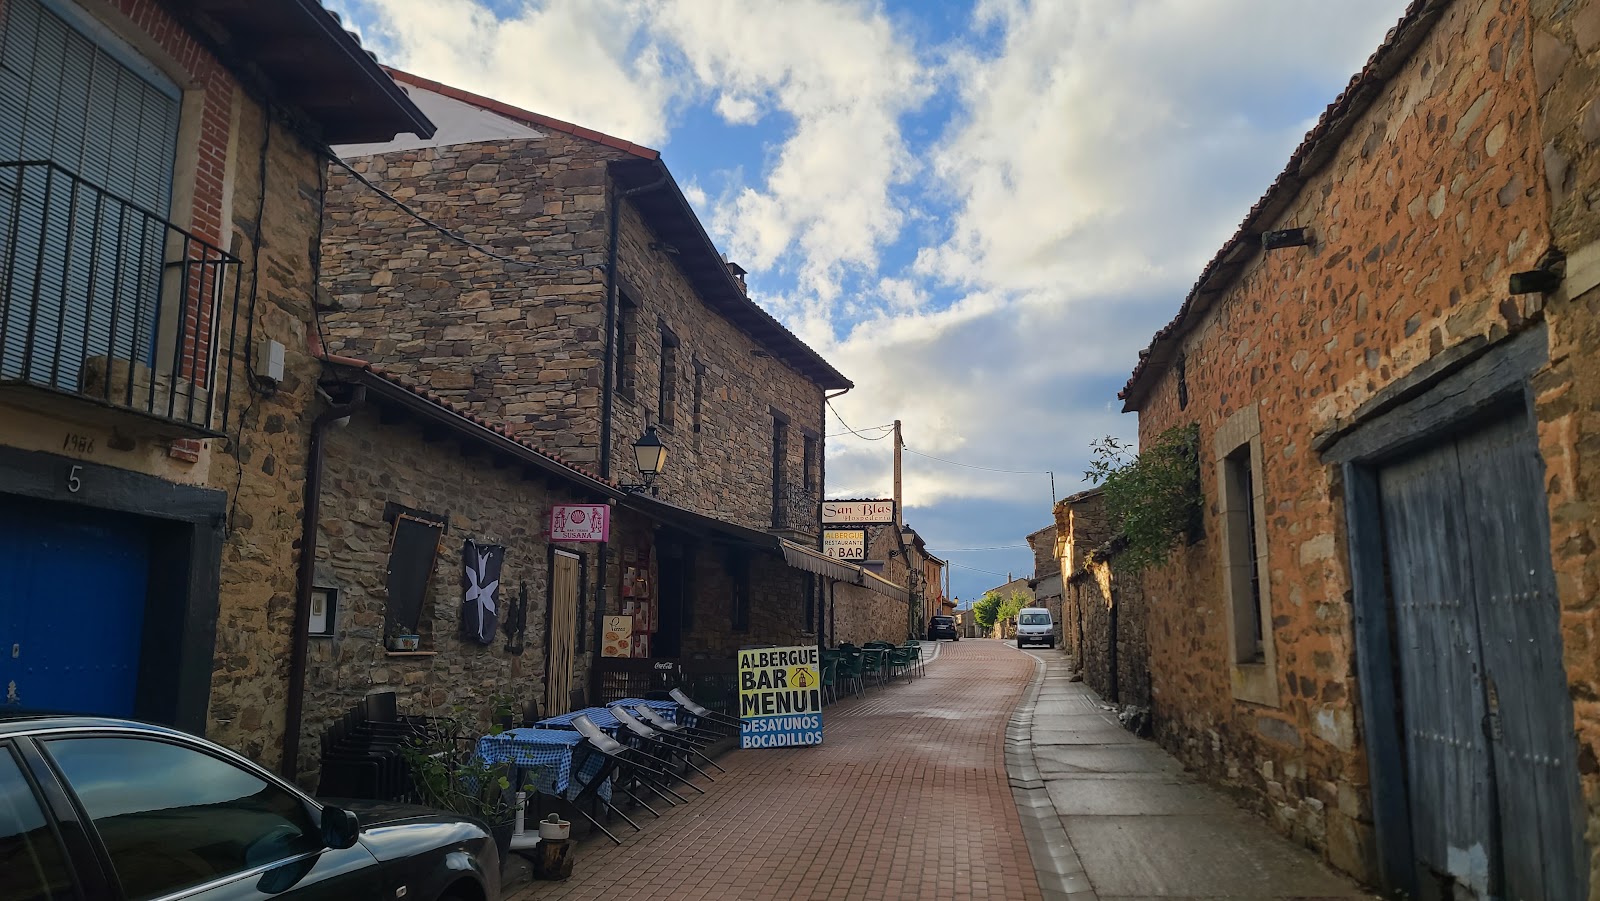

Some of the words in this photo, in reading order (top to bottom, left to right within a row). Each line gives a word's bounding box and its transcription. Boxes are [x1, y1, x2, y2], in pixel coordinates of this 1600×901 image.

[68, 465, 83, 493] 5
[823, 504, 852, 517] San
[857, 503, 892, 516] Blas
[838, 548, 863, 558] BAR
[740, 649, 818, 669] ALBERGUE
[741, 668, 788, 691] BAR
[742, 715, 819, 733] DESAYUNOS
[742, 731, 823, 749] BOCADILLOS
